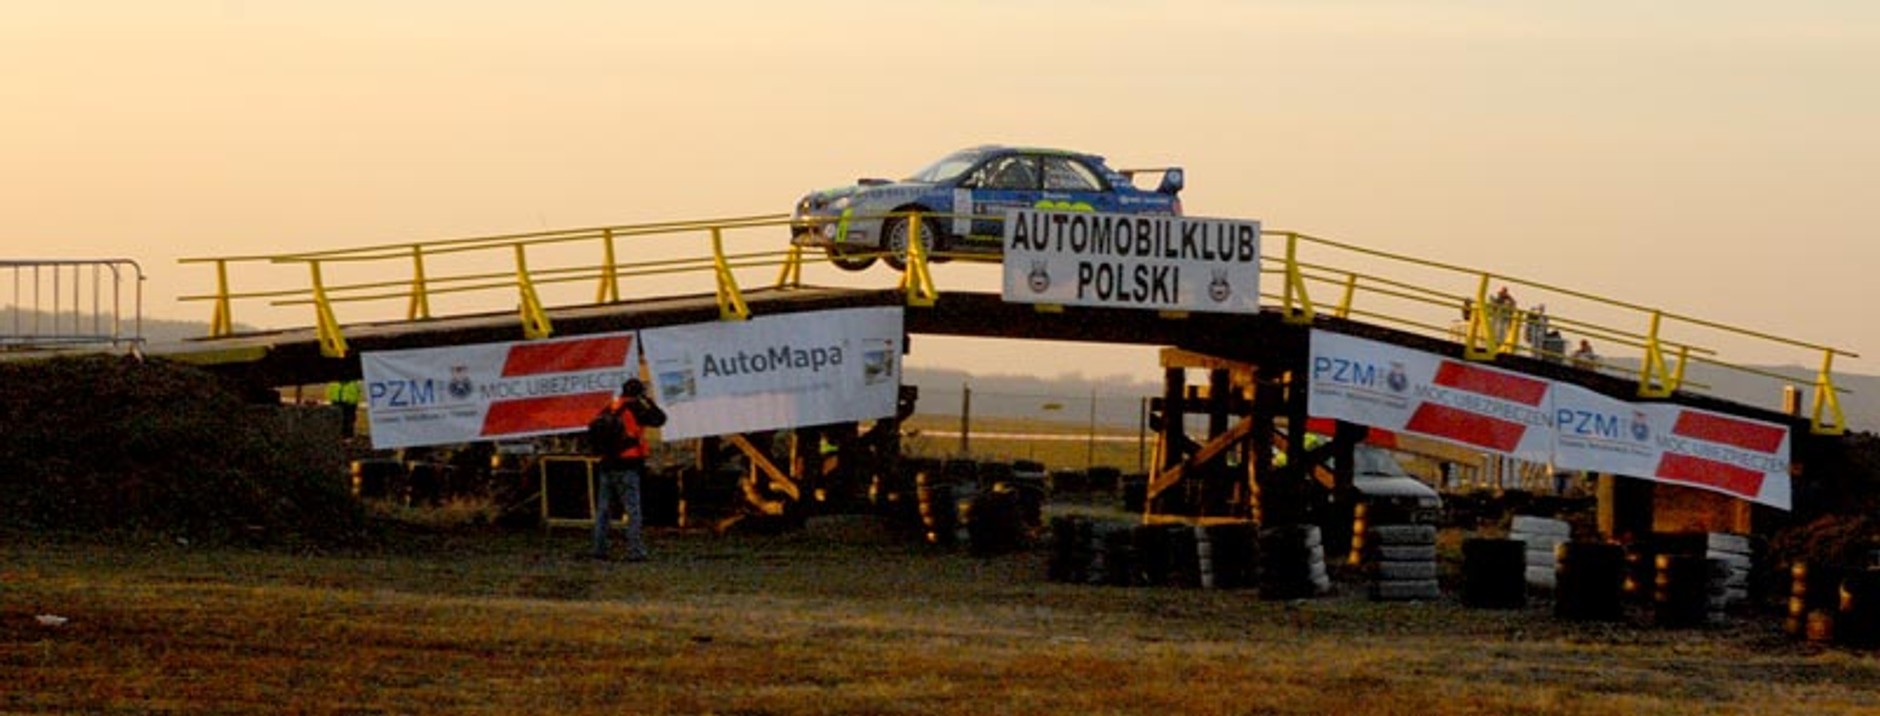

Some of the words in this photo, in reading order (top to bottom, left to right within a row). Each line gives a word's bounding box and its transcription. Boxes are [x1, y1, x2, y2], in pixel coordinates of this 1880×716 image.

[1011, 211, 1255, 262] AUTOMOBILKLUB
[1077, 261, 1180, 304] POLSKI
[702, 345, 843, 377] AutoMapa
[1314, 356, 1376, 387] PZM
[369, 378, 434, 408] PZM
[1557, 408, 1618, 438] PZM
